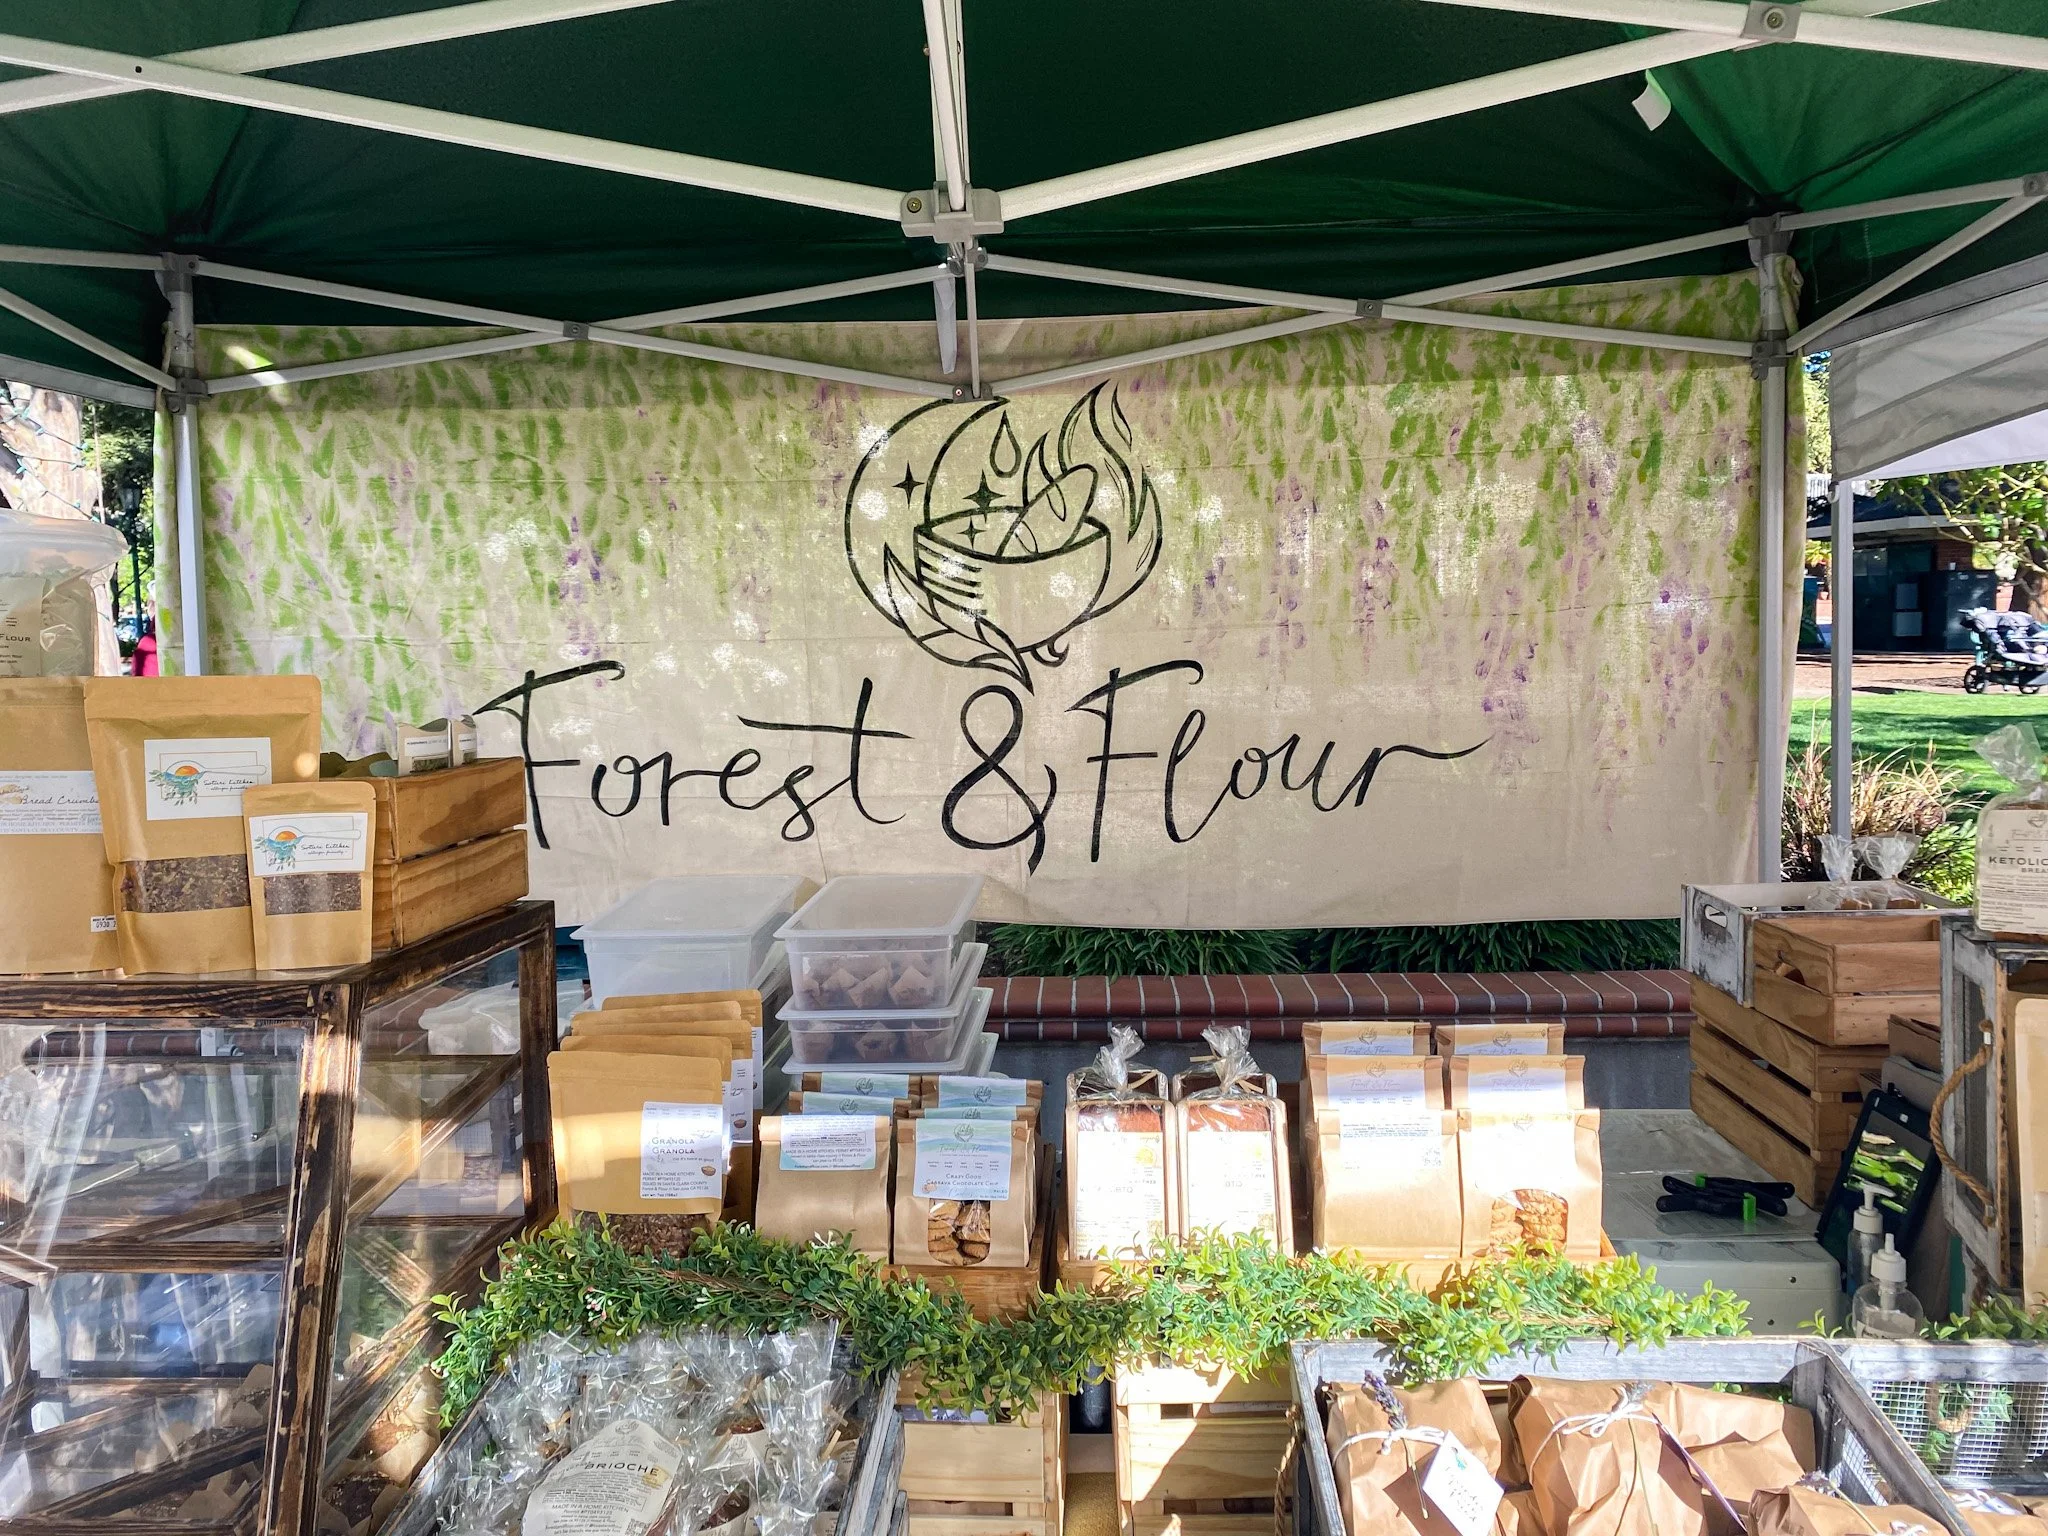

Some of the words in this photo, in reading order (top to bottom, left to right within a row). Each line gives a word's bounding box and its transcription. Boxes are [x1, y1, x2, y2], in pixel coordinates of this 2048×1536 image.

[473, 660, 915, 850] Forest
[941, 684, 1057, 877] &
[1065, 659, 1496, 863] Flour
[20, 794, 53, 805] Bread
[652, 1136, 695, 1145] GRANOLA
[652, 1146, 695, 1154] GRANOLA
[585, 1462, 659, 1477] BRIOCHE
